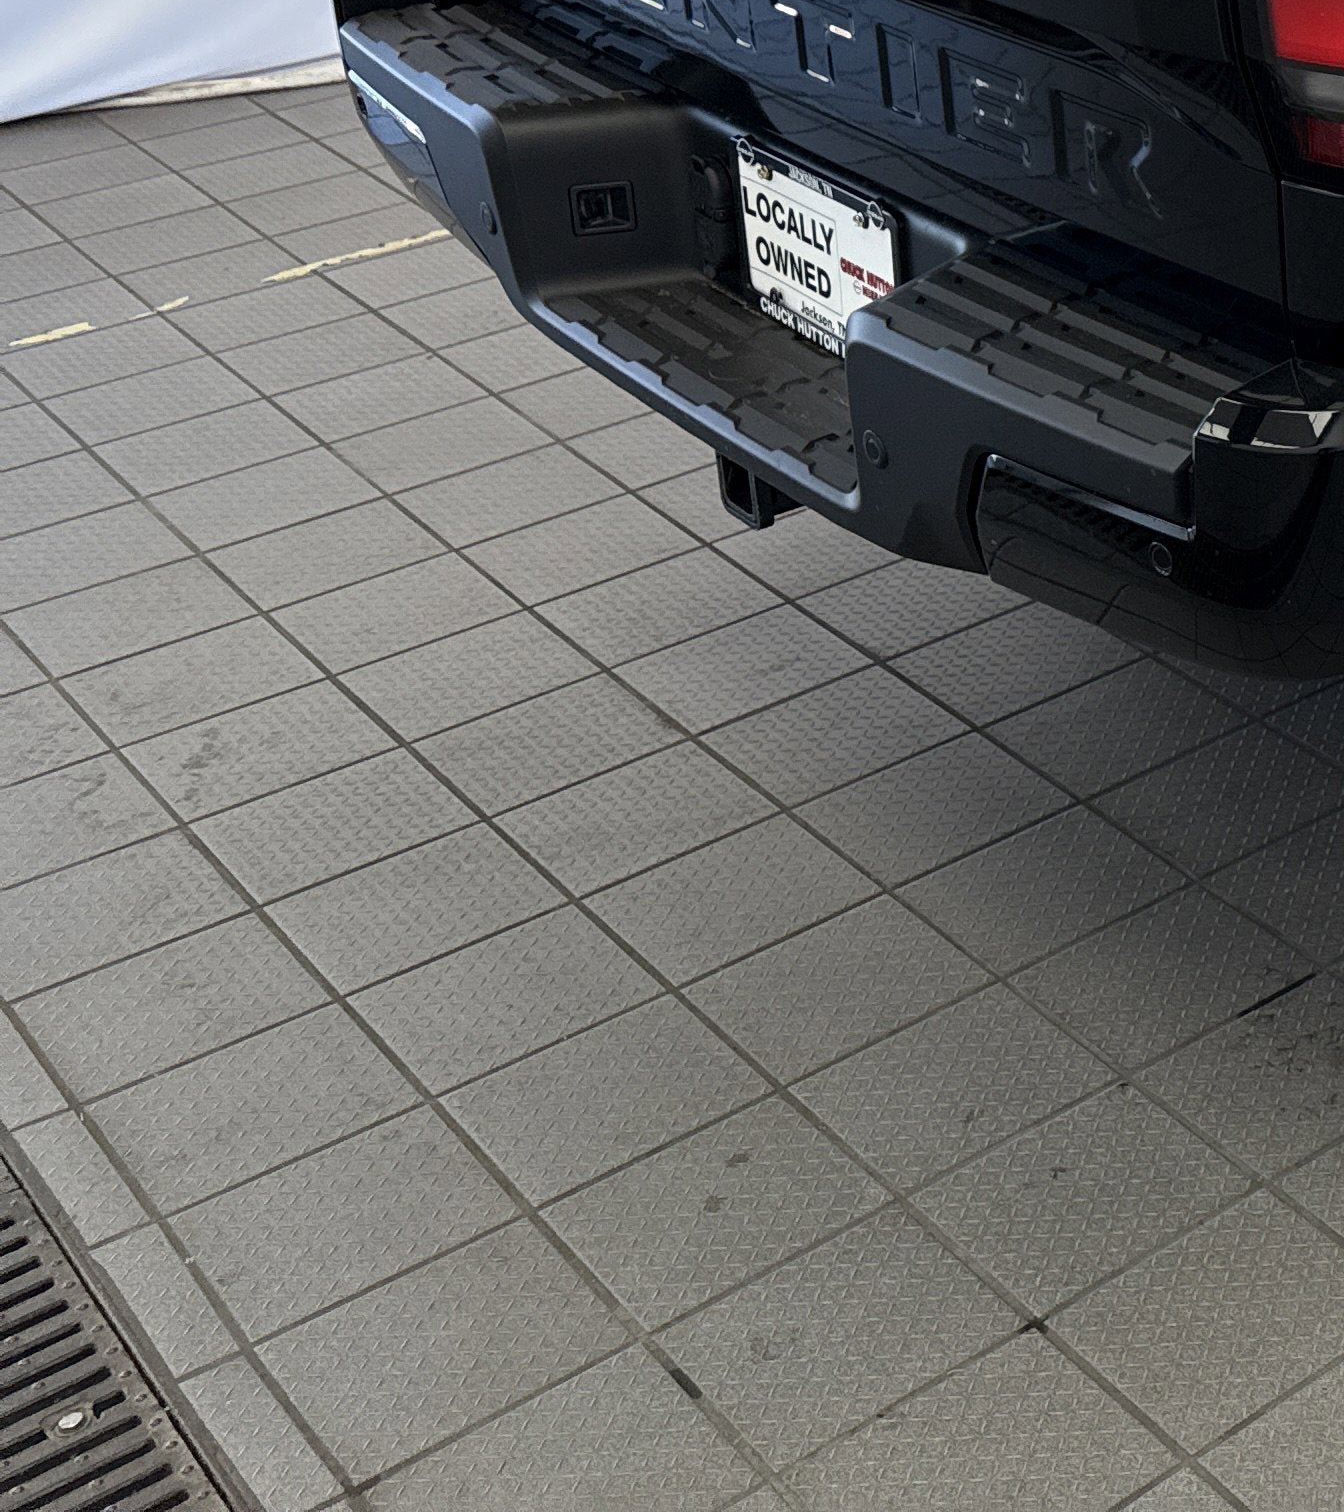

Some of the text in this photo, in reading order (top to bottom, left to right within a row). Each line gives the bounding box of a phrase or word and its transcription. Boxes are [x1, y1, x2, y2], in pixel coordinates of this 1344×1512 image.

[742, 185, 834, 255] LOCALLY
[755, 236, 832, 299] OWNED
[760, 296, 795, 330] CHUCK
[795, 314, 839, 356] HUTTON
